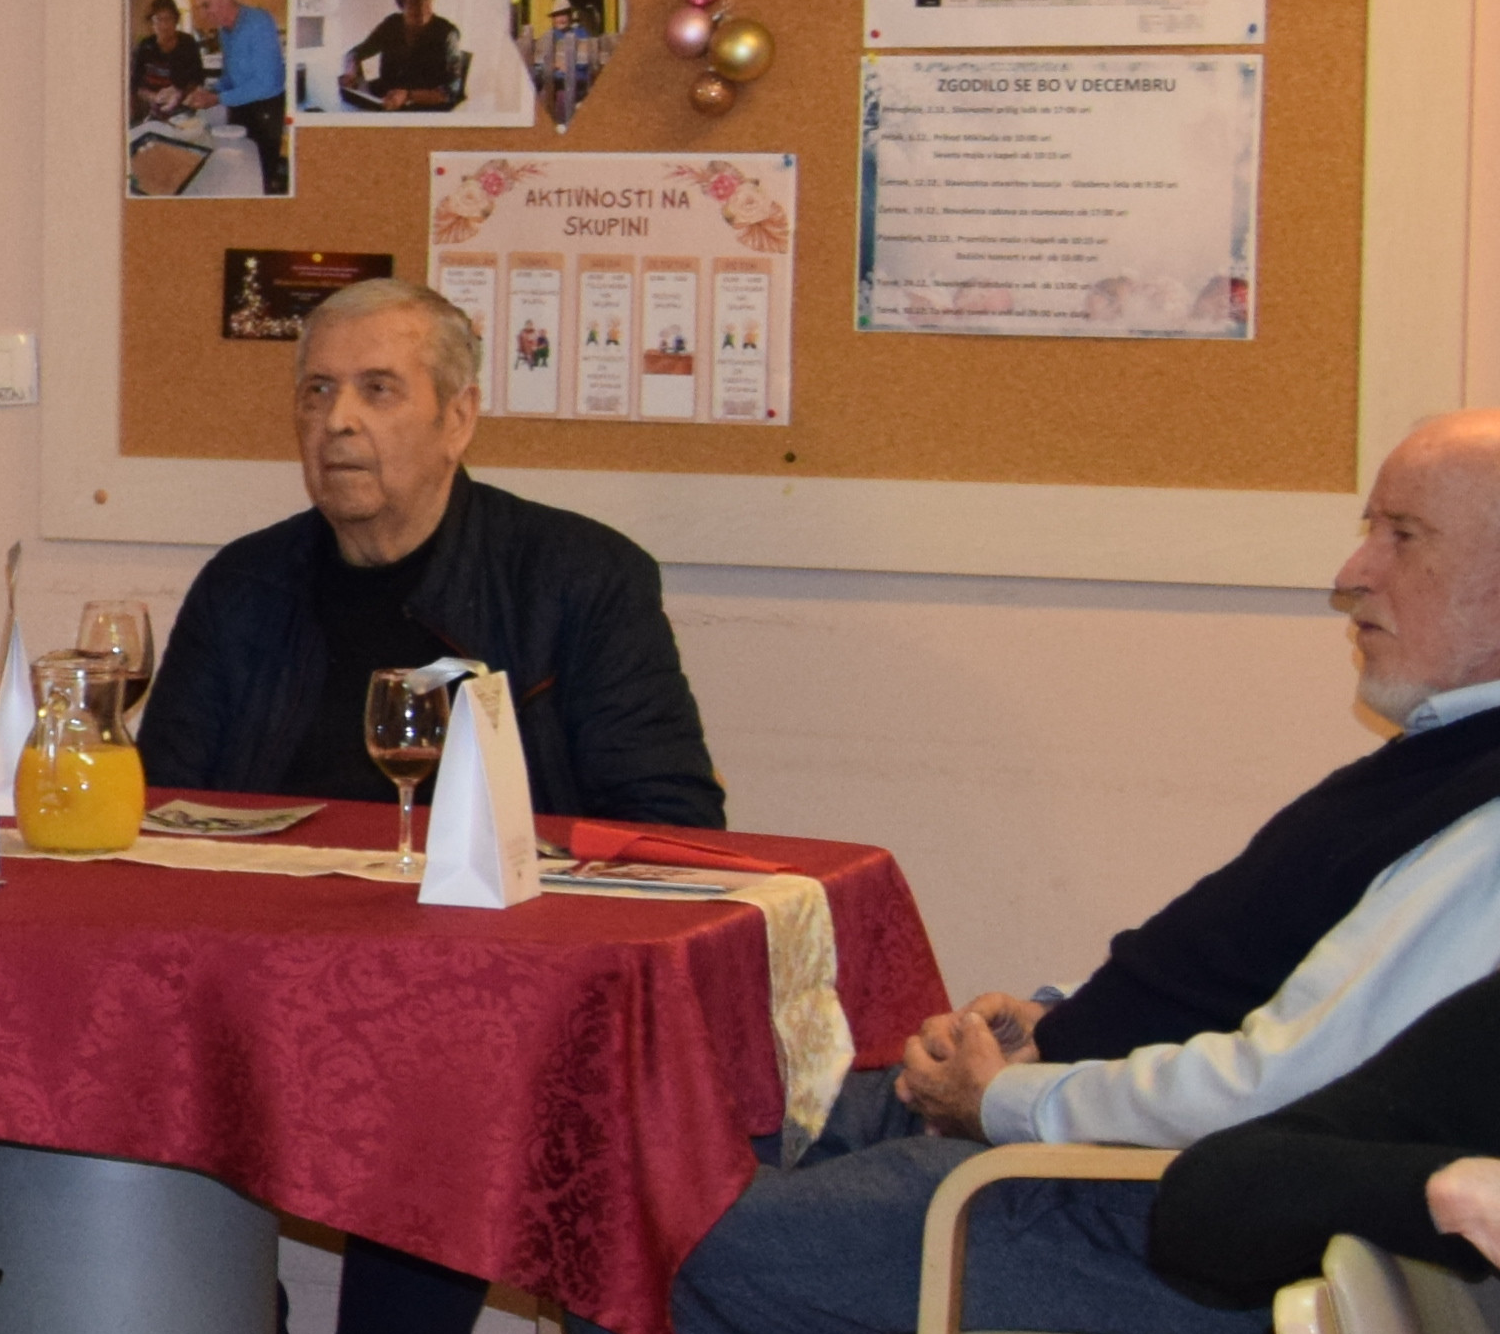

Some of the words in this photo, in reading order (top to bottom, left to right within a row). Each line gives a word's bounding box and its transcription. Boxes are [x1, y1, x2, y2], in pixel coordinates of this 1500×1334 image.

[937, 78, 1009, 94] ZGODILO
[1013, 78, 1035, 93] SE
[1038, 78, 1060, 93] BO
[1064, 78, 1078, 93] V
[1082, 77, 1177, 93] DECEMBRU
[525, 187, 654, 210] AKTIVNOSTI
[661, 187, 691, 210] NA
[563, 216, 650, 238] SKUPINI
